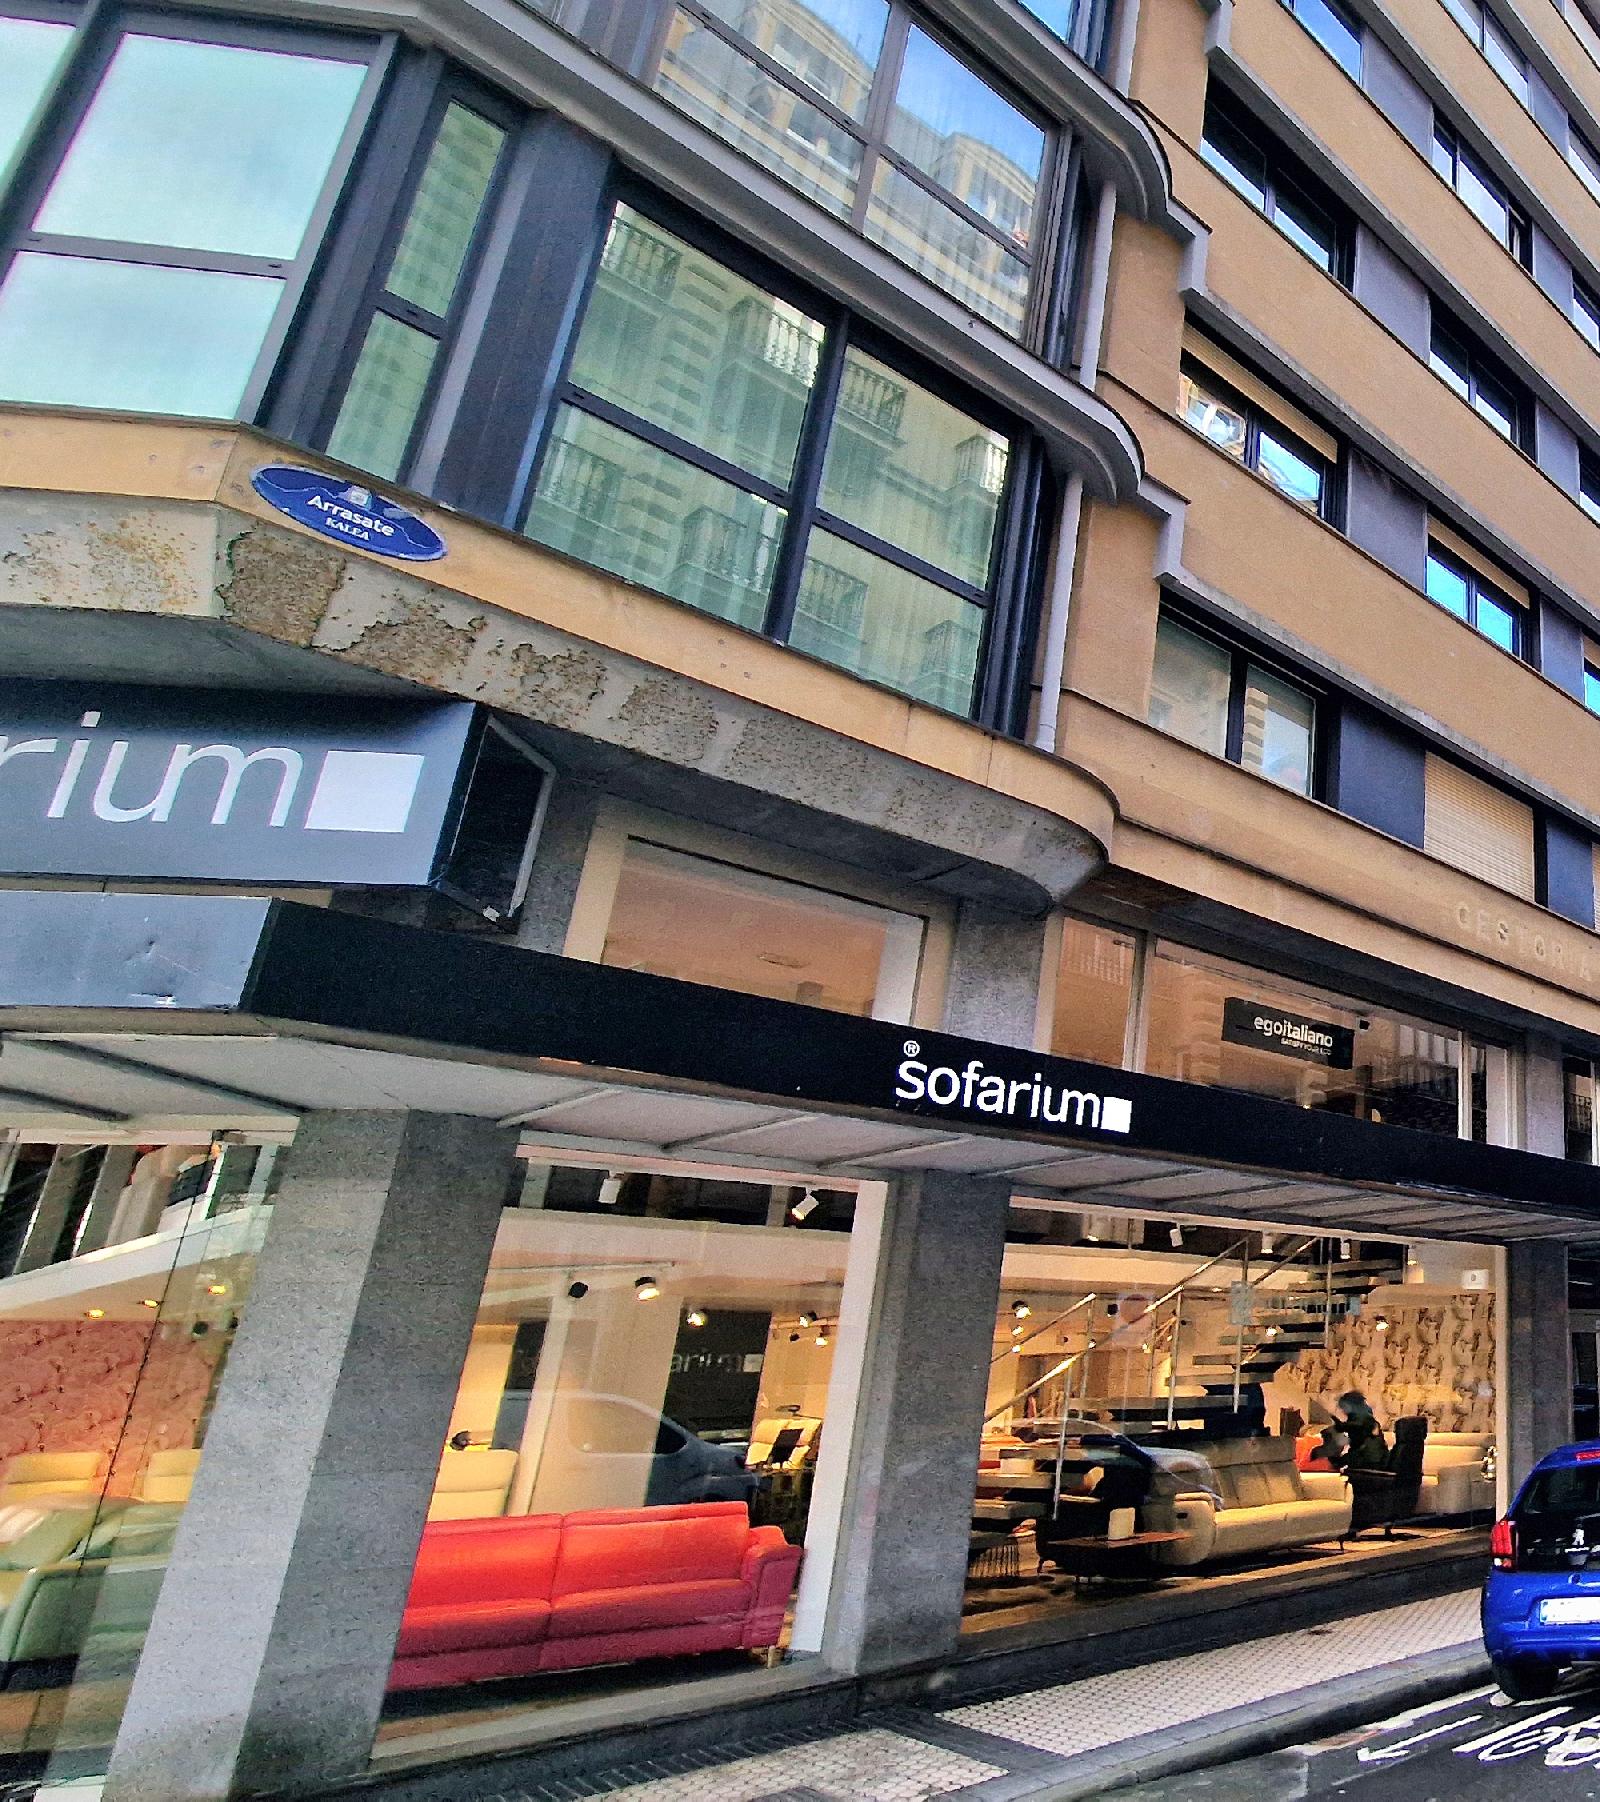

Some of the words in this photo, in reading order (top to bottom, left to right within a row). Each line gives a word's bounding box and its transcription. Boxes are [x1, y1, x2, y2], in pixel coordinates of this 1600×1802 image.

[307, 494, 395, 537] Arrasate
[325, 517, 370, 541] KALEA
[1253, 1016, 1333, 1049] egoitaliano
[895, 1060, 1101, 1128] sofarium
